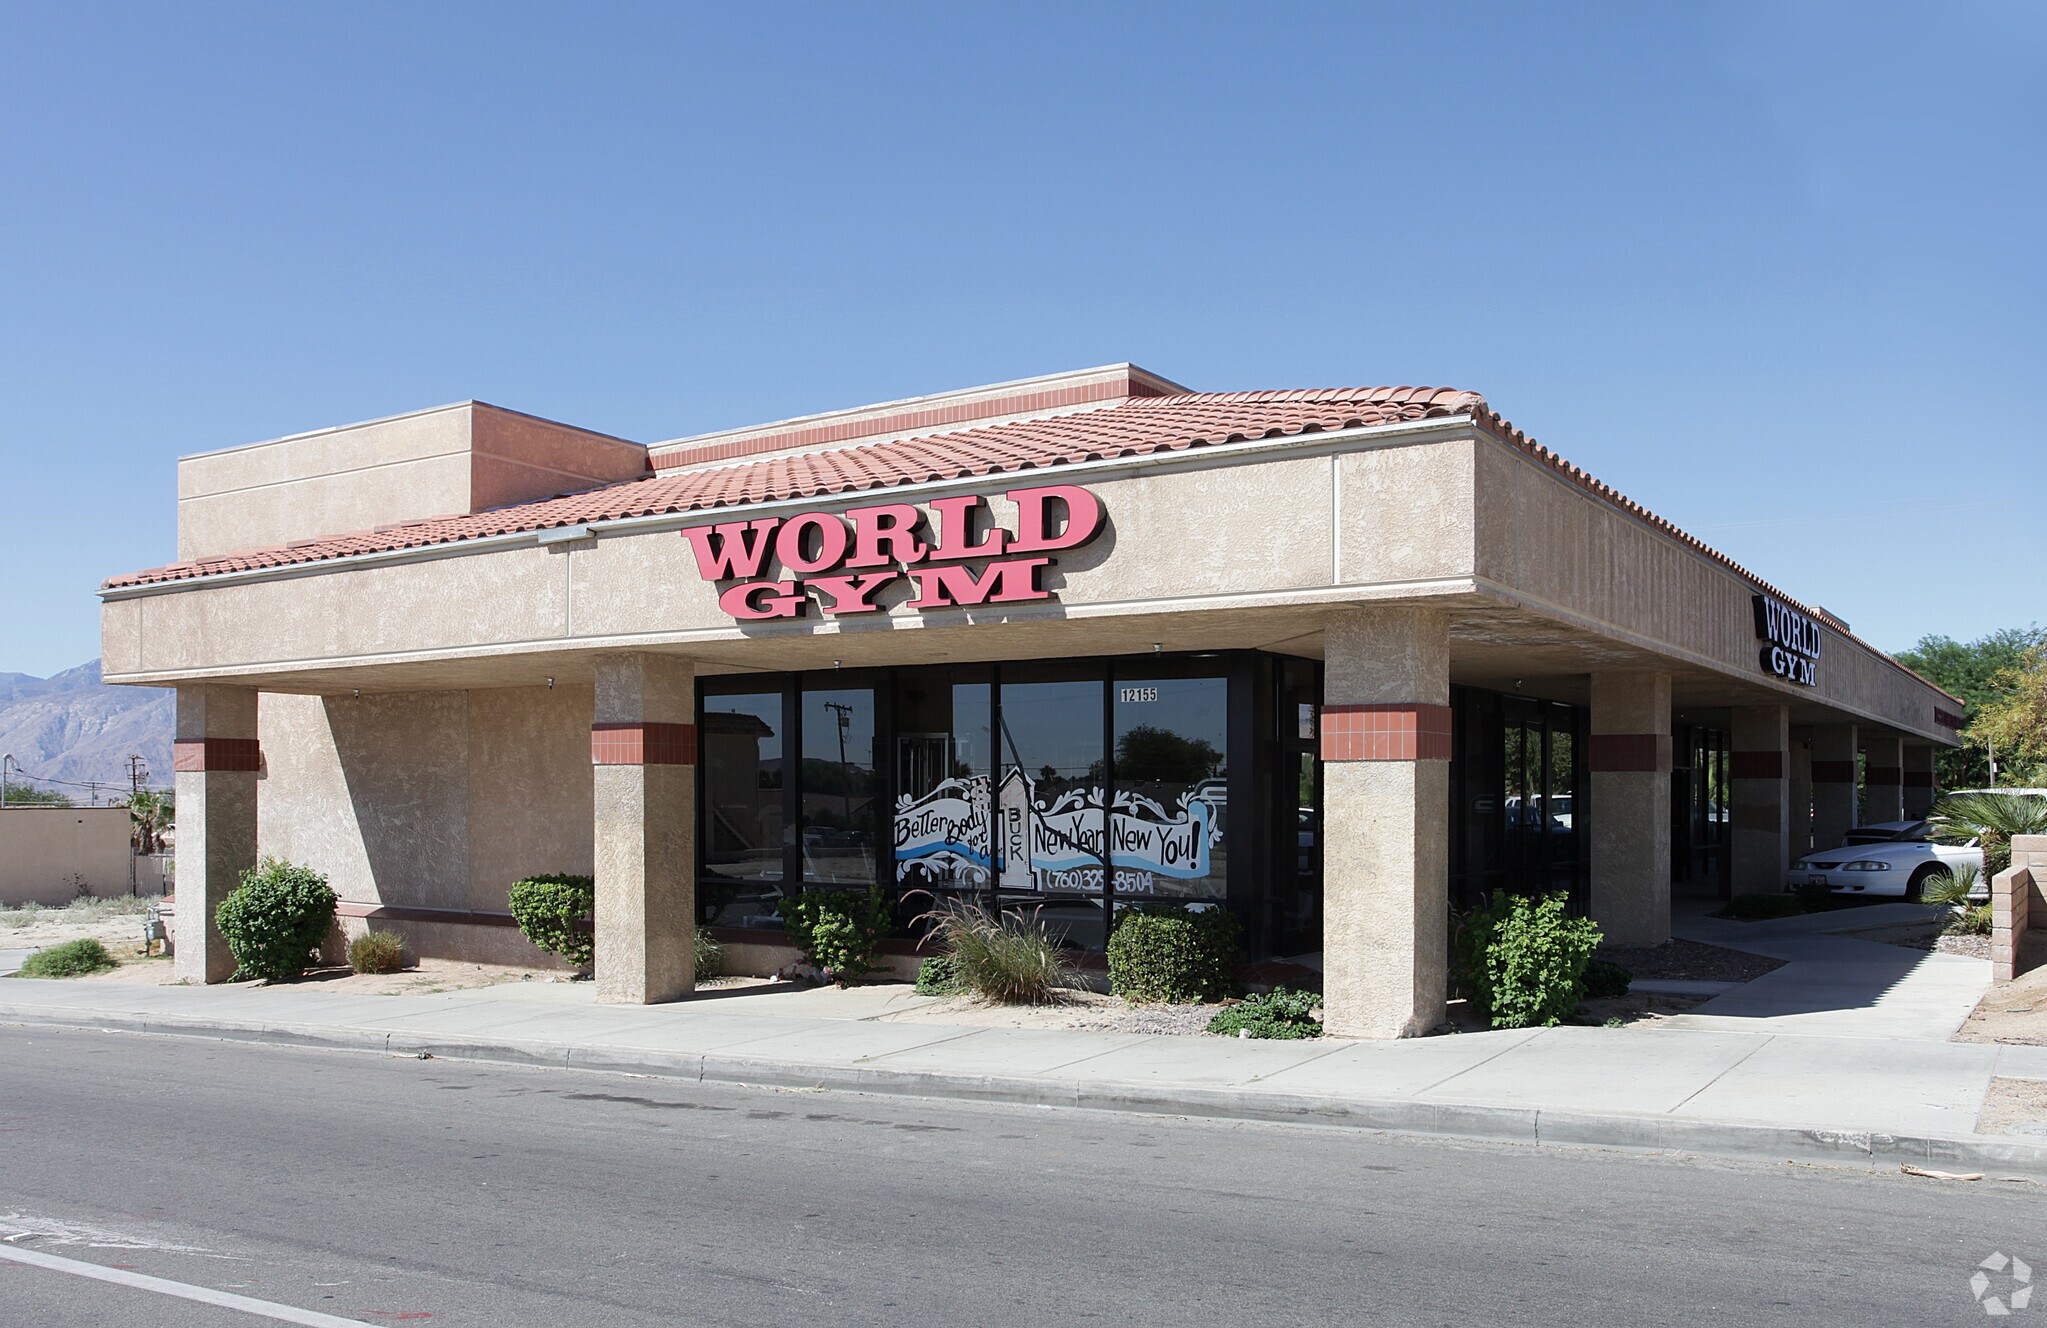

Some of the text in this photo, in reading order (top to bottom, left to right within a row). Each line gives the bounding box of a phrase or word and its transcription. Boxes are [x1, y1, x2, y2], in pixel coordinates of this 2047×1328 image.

[681, 484, 1103, 581] WORLD
[718, 557, 1054, 620] GYM
[1759, 595, 1821, 660] WORLD
[1768, 646, 1817, 687] GYM
[1122, 688, 1156, 702] 12155
[894, 805, 989, 847] Better Body
[967, 832, 989, 856] for
[1008, 807, 1024, 862] BUCK
[1035, 823, 1073, 855] New
[1113, 818, 1152, 852] New
[1156, 820, 1201, 870] You!
[979, 844, 992, 860] a
